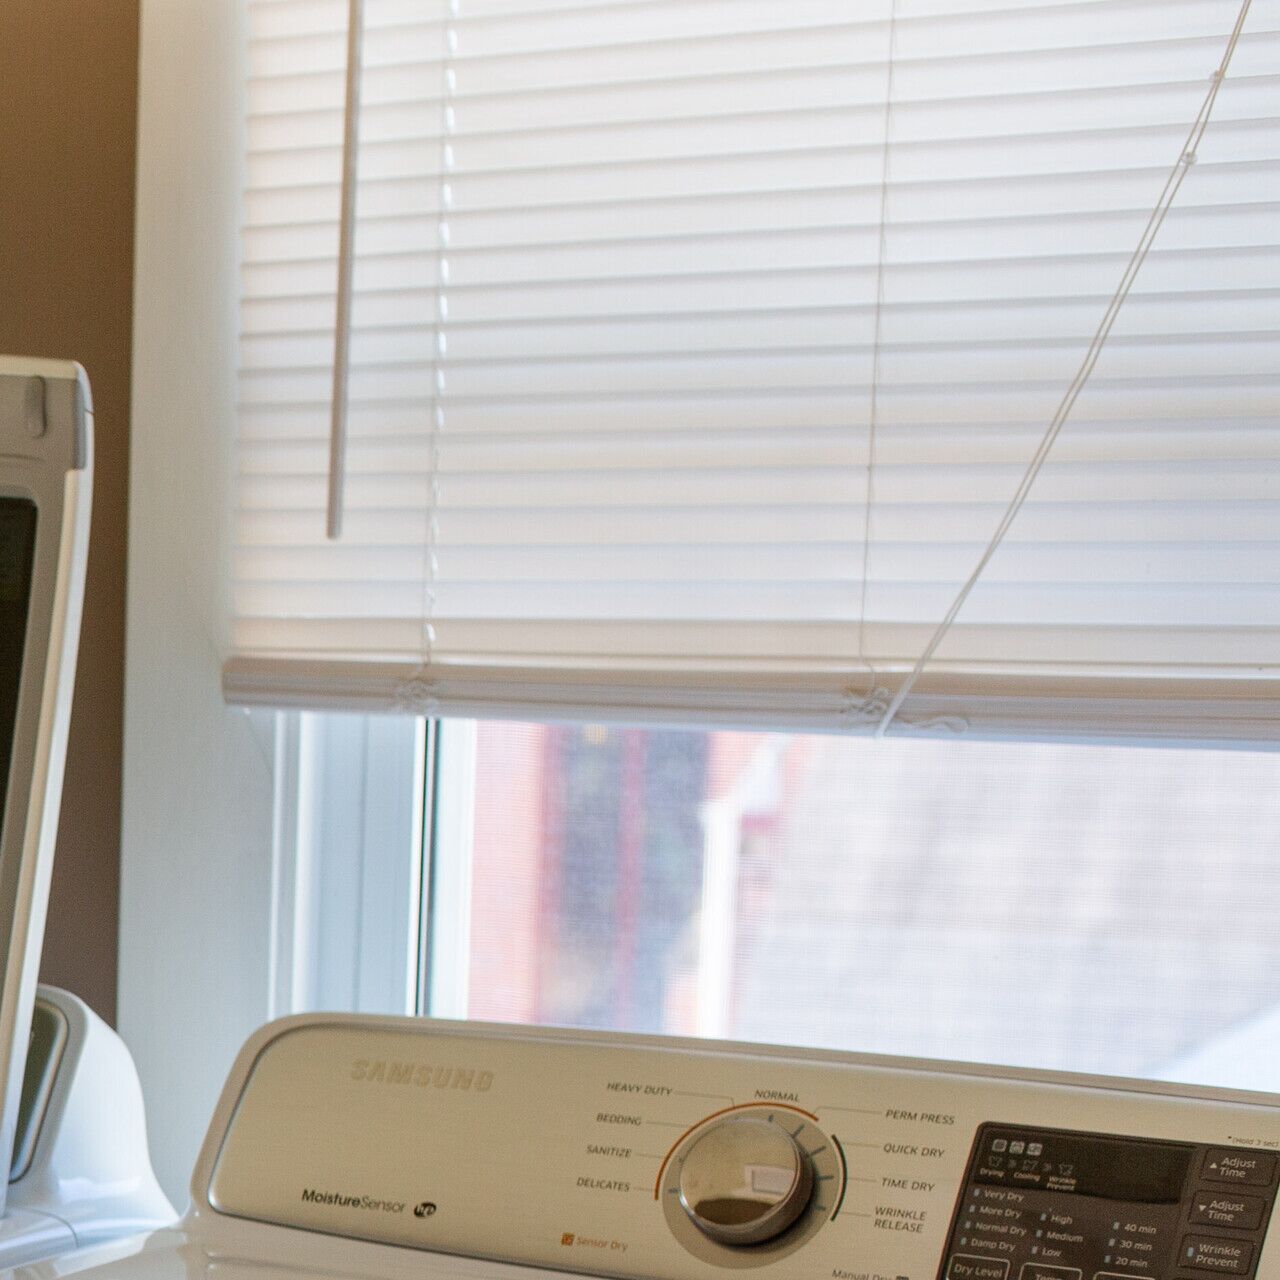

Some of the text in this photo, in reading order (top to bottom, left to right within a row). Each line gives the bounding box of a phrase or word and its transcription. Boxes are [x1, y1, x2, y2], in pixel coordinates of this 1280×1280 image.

[350, 1059, 495, 1092] SAMSUNG
[607, 1082, 673, 1096] HEAVY DUTY
[754, 1089, 800, 1102] NORMAL
[596, 1113, 642, 1126] BEDDING
[885, 1109, 956, 1125] PERM PRESS
[586, 1145, 632, 1158] SANITIZE
[883, 1143, 945, 1158] QUICK DRY
[1221, 1157, 1256, 1169] Adjust
[1219, 1167, 1246, 1178] Time
[576, 1177, 630, 1192] DELICATES
[881, 1177, 936, 1192] TIME DRY
[301, 1188, 406, 1214] MoistureSensor
[984, 1190, 1024, 1202] Very Dry
[979, 1206, 1022, 1218] More Dry
[1209, 1200, 1244, 1212] Adjust
[874, 1206, 927, 1221] WRINKLE
[1051, 1215, 1073, 1225] High
[1208, 1210, 1234, 1221] Time
[874, 1220, 924, 1234] RELEASE
[975, 1222, 1027, 1237] Normal Dry
[1124, 1223, 1157, 1234] 40 min
[1047, 1231, 1083, 1242] Medium
[577, 1236, 629, 1251] Sensor Dry
[971, 1238, 1016, 1252] Damp Dry
[1119, 1240, 1152, 1251] 30 min
[1199, 1243, 1241, 1257] Wrinkle
[1042, 1247, 1061, 1258] Low
[1115, 1257, 1148, 1268] 20 min
[1196, 1254, 1239, 1268] Prevent
[954, 1264, 1003, 1278] Dry Level
